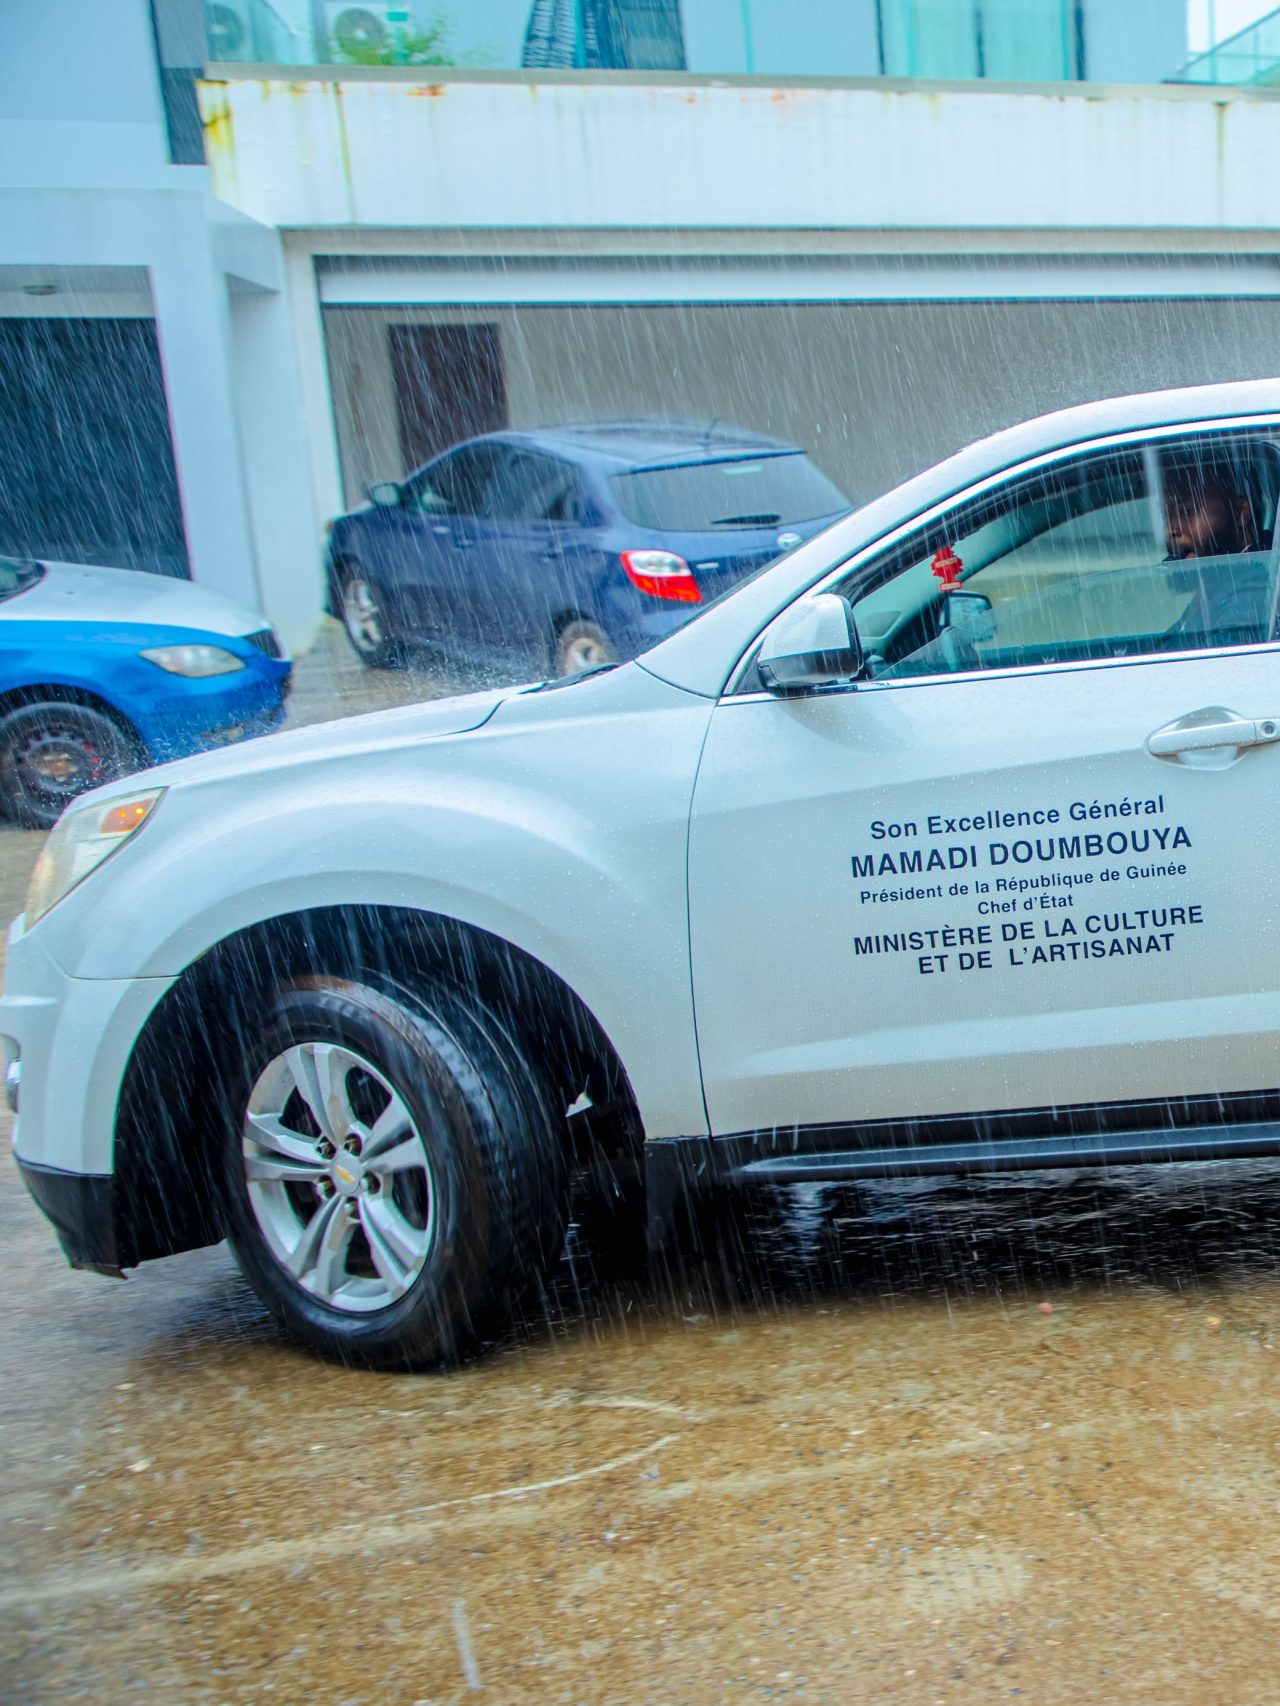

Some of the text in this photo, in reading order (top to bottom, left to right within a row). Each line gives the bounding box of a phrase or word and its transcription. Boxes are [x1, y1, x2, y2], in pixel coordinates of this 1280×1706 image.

[870, 794, 1165, 840] Son Excellence Général
[850, 825, 1193, 879] MAMADI DOUMBOUYA
[860, 862, 1187, 905] Président de la République de Guinée
[977, 893, 1074, 915] Chef d'État
[853, 904, 1204, 956] MINISTÈRE DE LA CULTURE
[918, 932, 1175, 975] ET DE L'ARTISANAT
